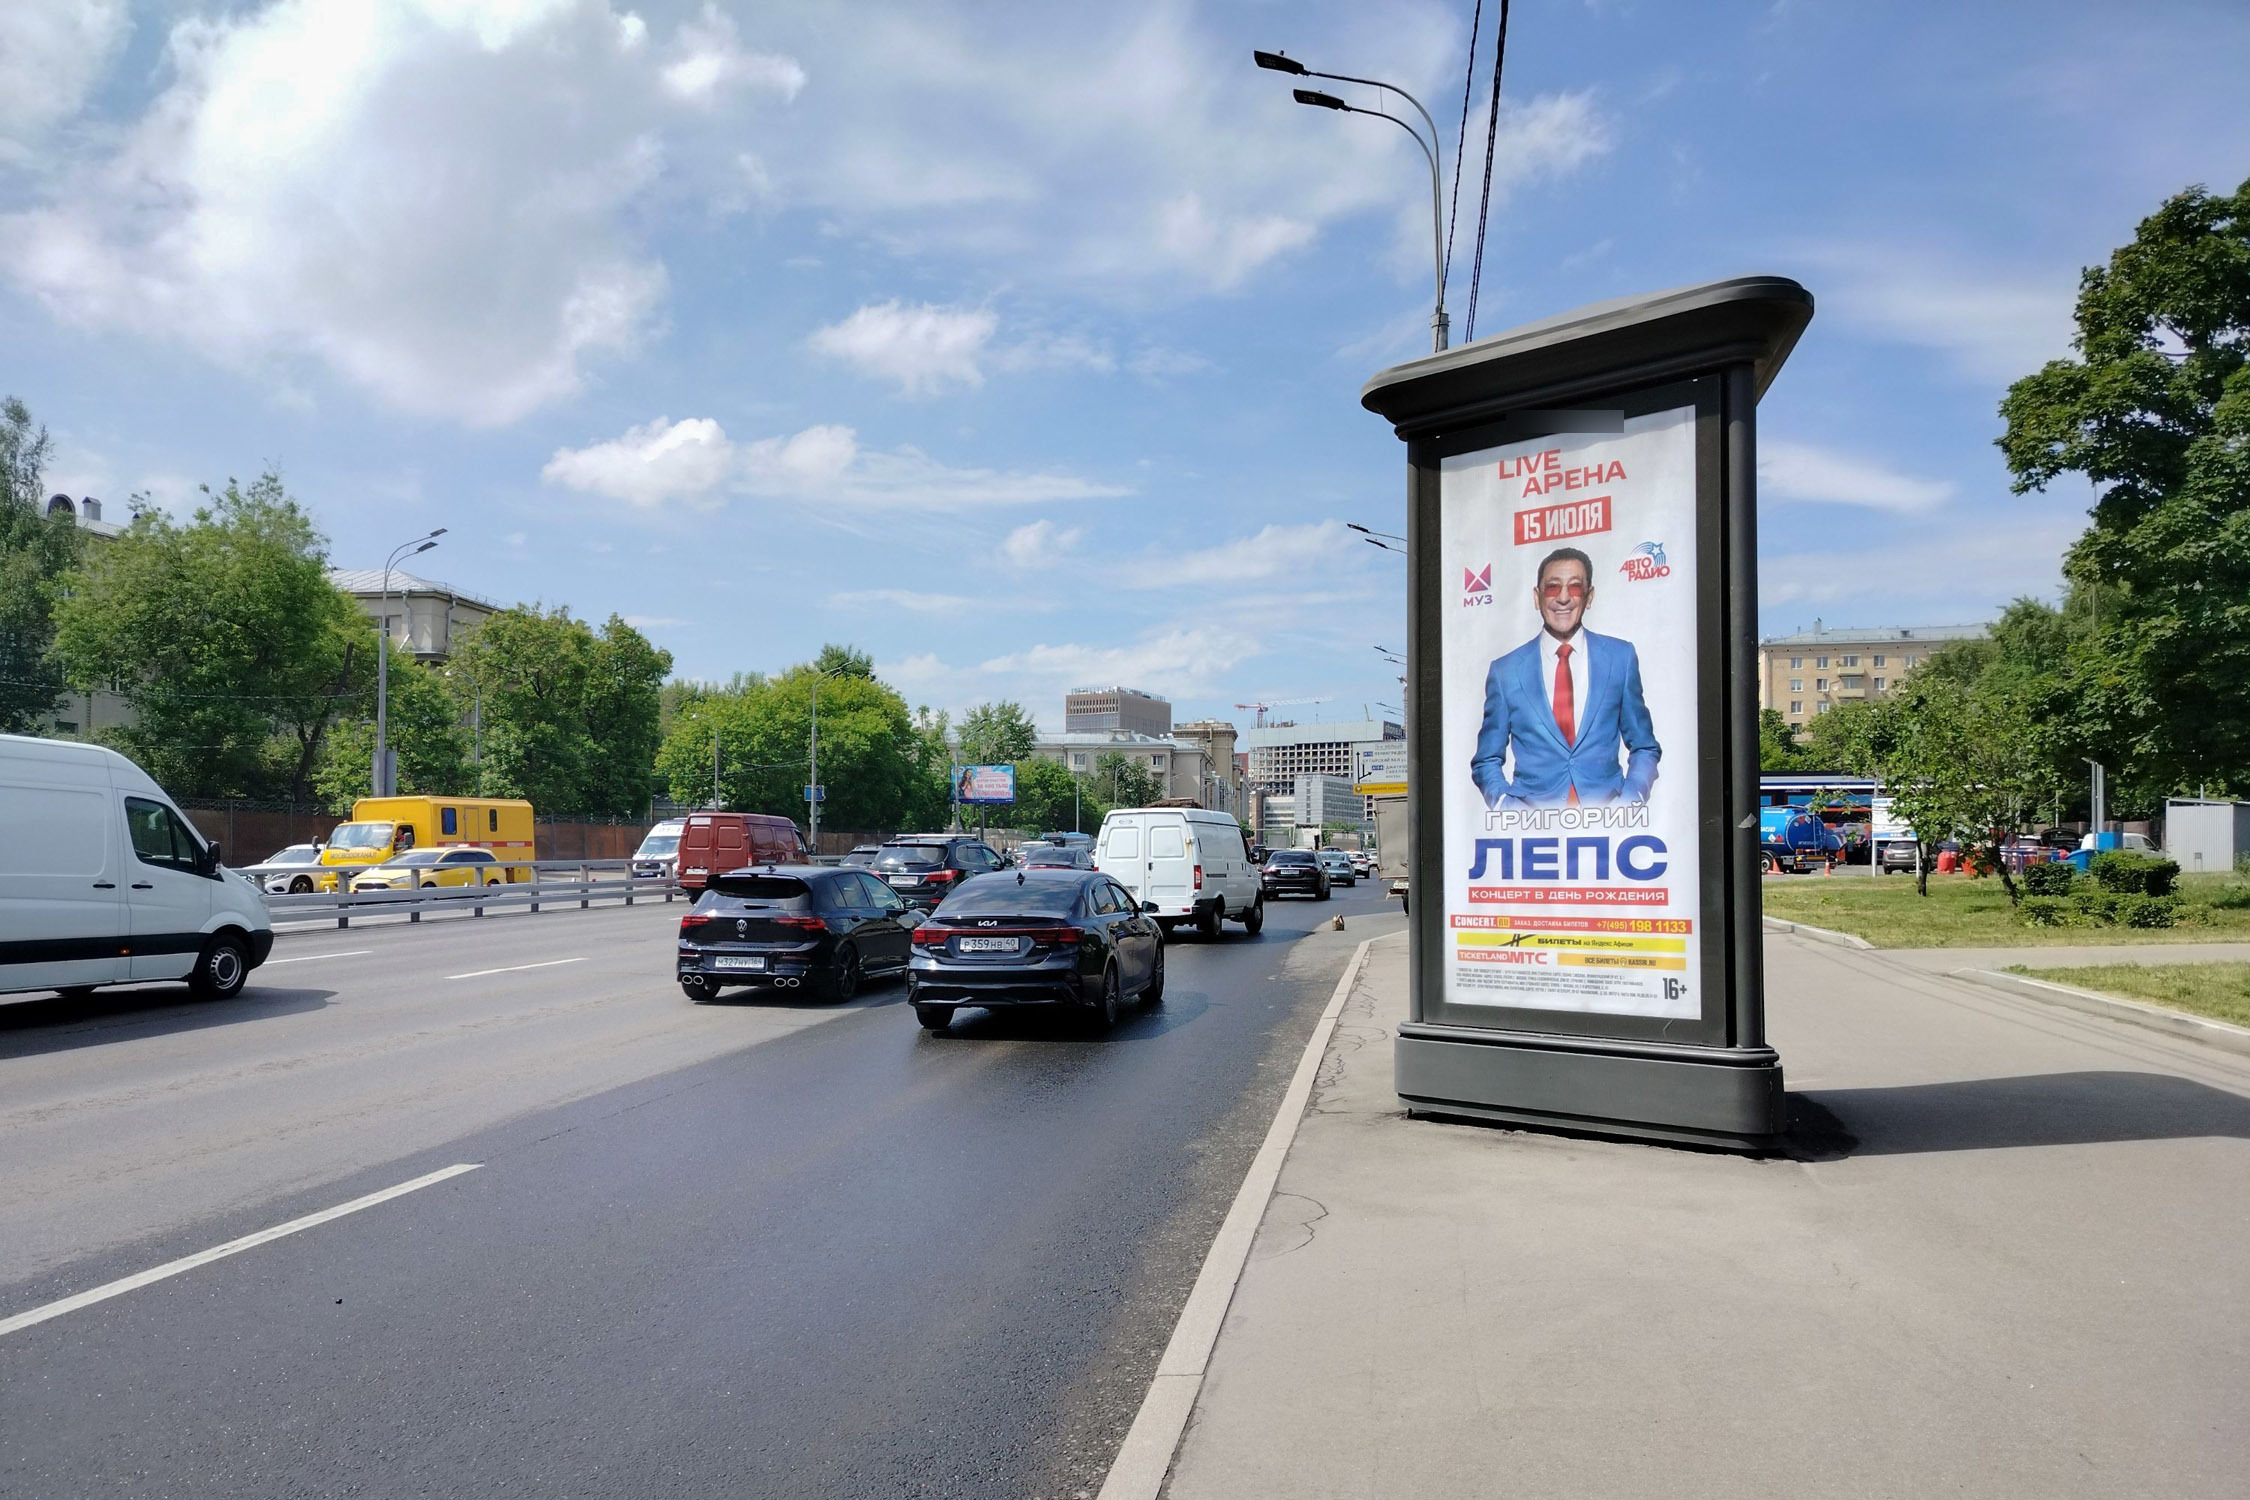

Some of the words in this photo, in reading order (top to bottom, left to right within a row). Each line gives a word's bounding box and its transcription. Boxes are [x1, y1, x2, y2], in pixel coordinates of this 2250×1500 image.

[1499, 449, 1561, 480] LIVE
[1522, 460, 1627, 498] АРЕНА
[1522, 512, 1541, 541] 15
[1545, 501, 1603, 537] ИЮЛЯ
[1619, 557, 1652, 573] АВТО
[1628, 565, 1671, 582] РАДИО
[1463, 594, 1493, 608] МУЗ
[1485, 801, 1649, 831] ГРИГОРИЙ
[1468, 835, 1668, 881] ЛЕПС
[1471, 890, 1531, 900] КОНЦЕРТ
[1535, 890, 1544, 900] В
[1548, 891, 1582, 901] ДЕНЬ
[1586, 891, 1665, 902] РОЖДЕНИЯ
[1629, 920, 1652, 932] 198
[1656, 921, 1687, 933] 1133
[1537, 938, 1581, 946] БИЛЕТЫ
[1459, 951, 1508, 961] TICKETLAND
[1508, 951, 1547, 965] МТС
[1662, 977, 1688, 1000] 16+
